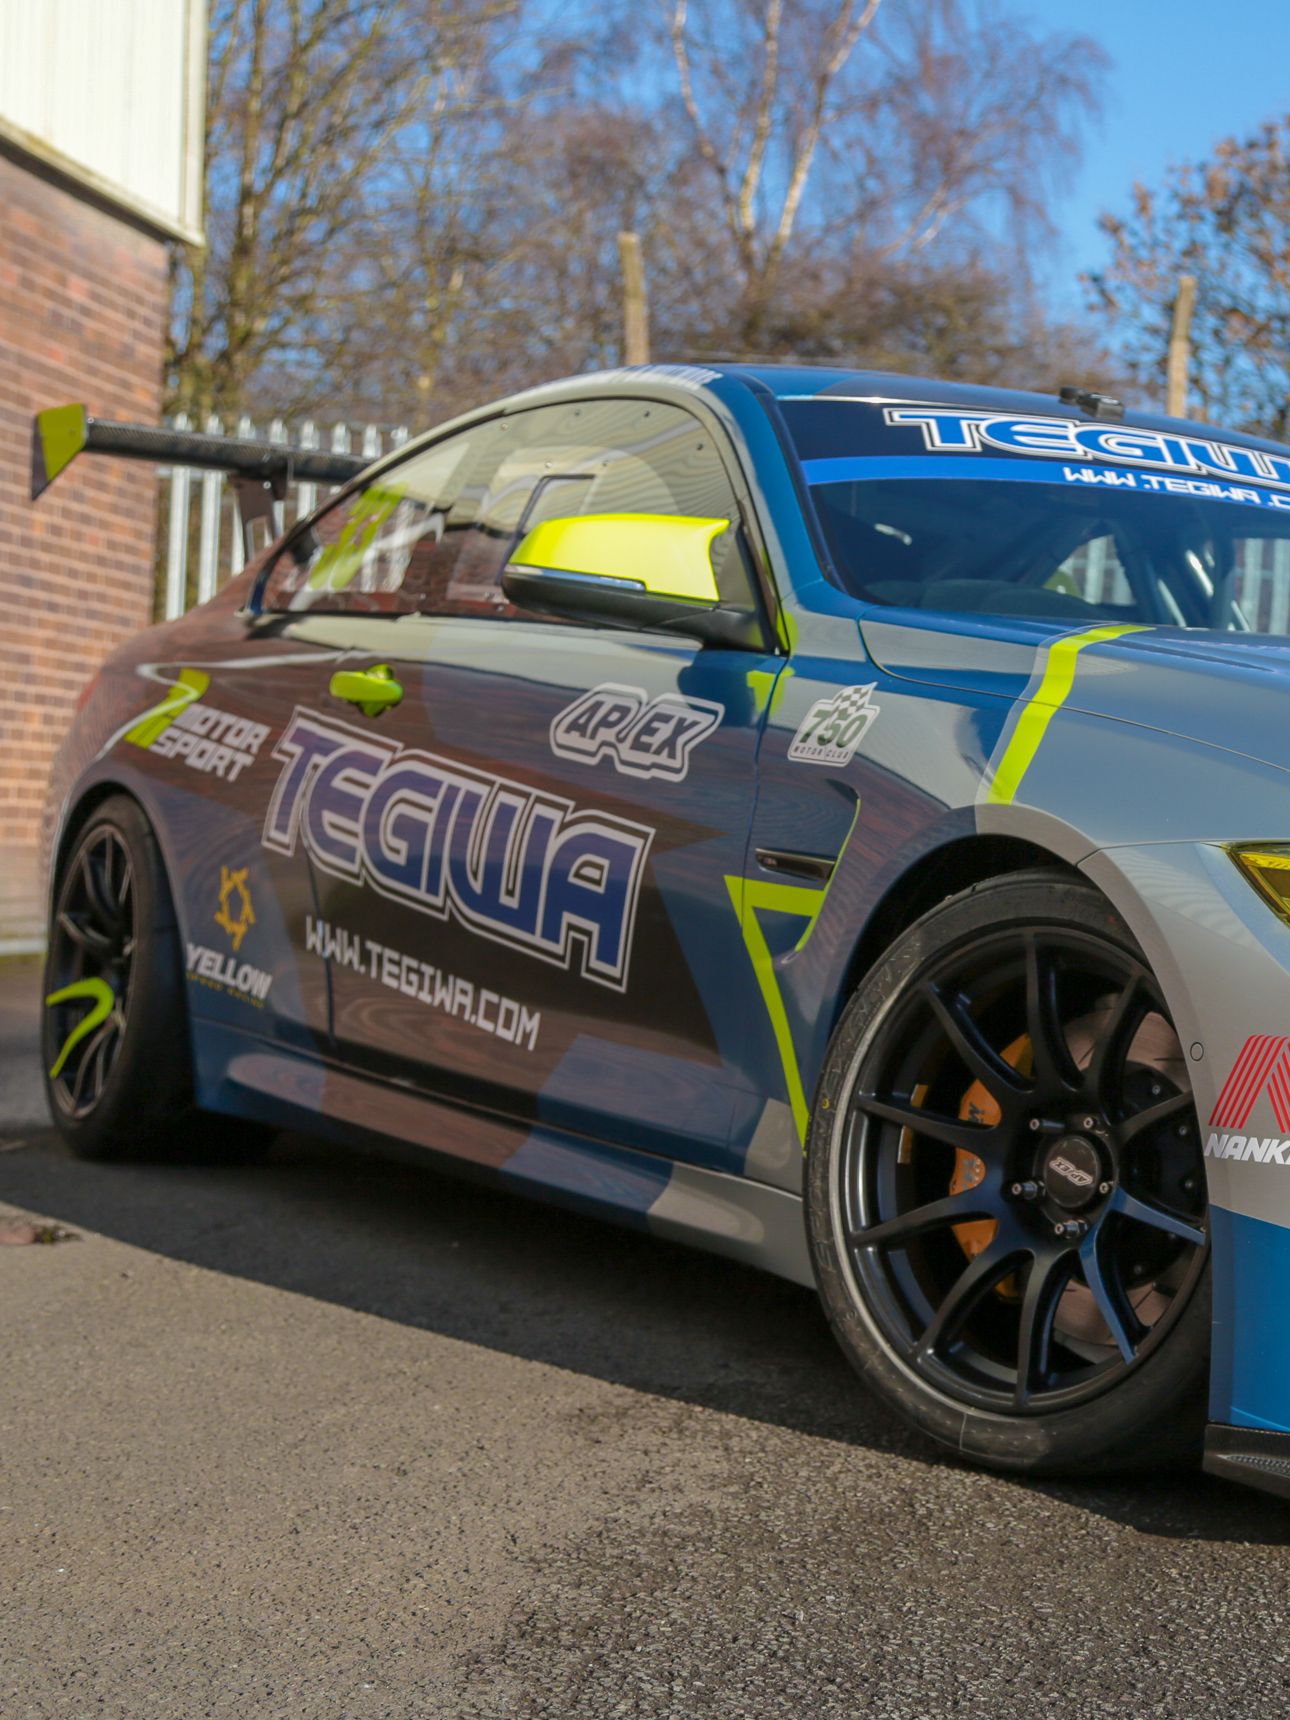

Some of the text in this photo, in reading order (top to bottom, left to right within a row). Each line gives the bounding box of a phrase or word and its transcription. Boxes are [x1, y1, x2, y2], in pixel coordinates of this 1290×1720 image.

[148, 725, 256, 783] SPORT
[172, 701, 273, 755] MOTOR
[799, 708, 869, 749] 750
[262, 705, 656, 993] TEGIWA
[185, 942, 273, 1000] YELLOW
[305, 915, 542, 1052] WWW.TEGIWA.COM
